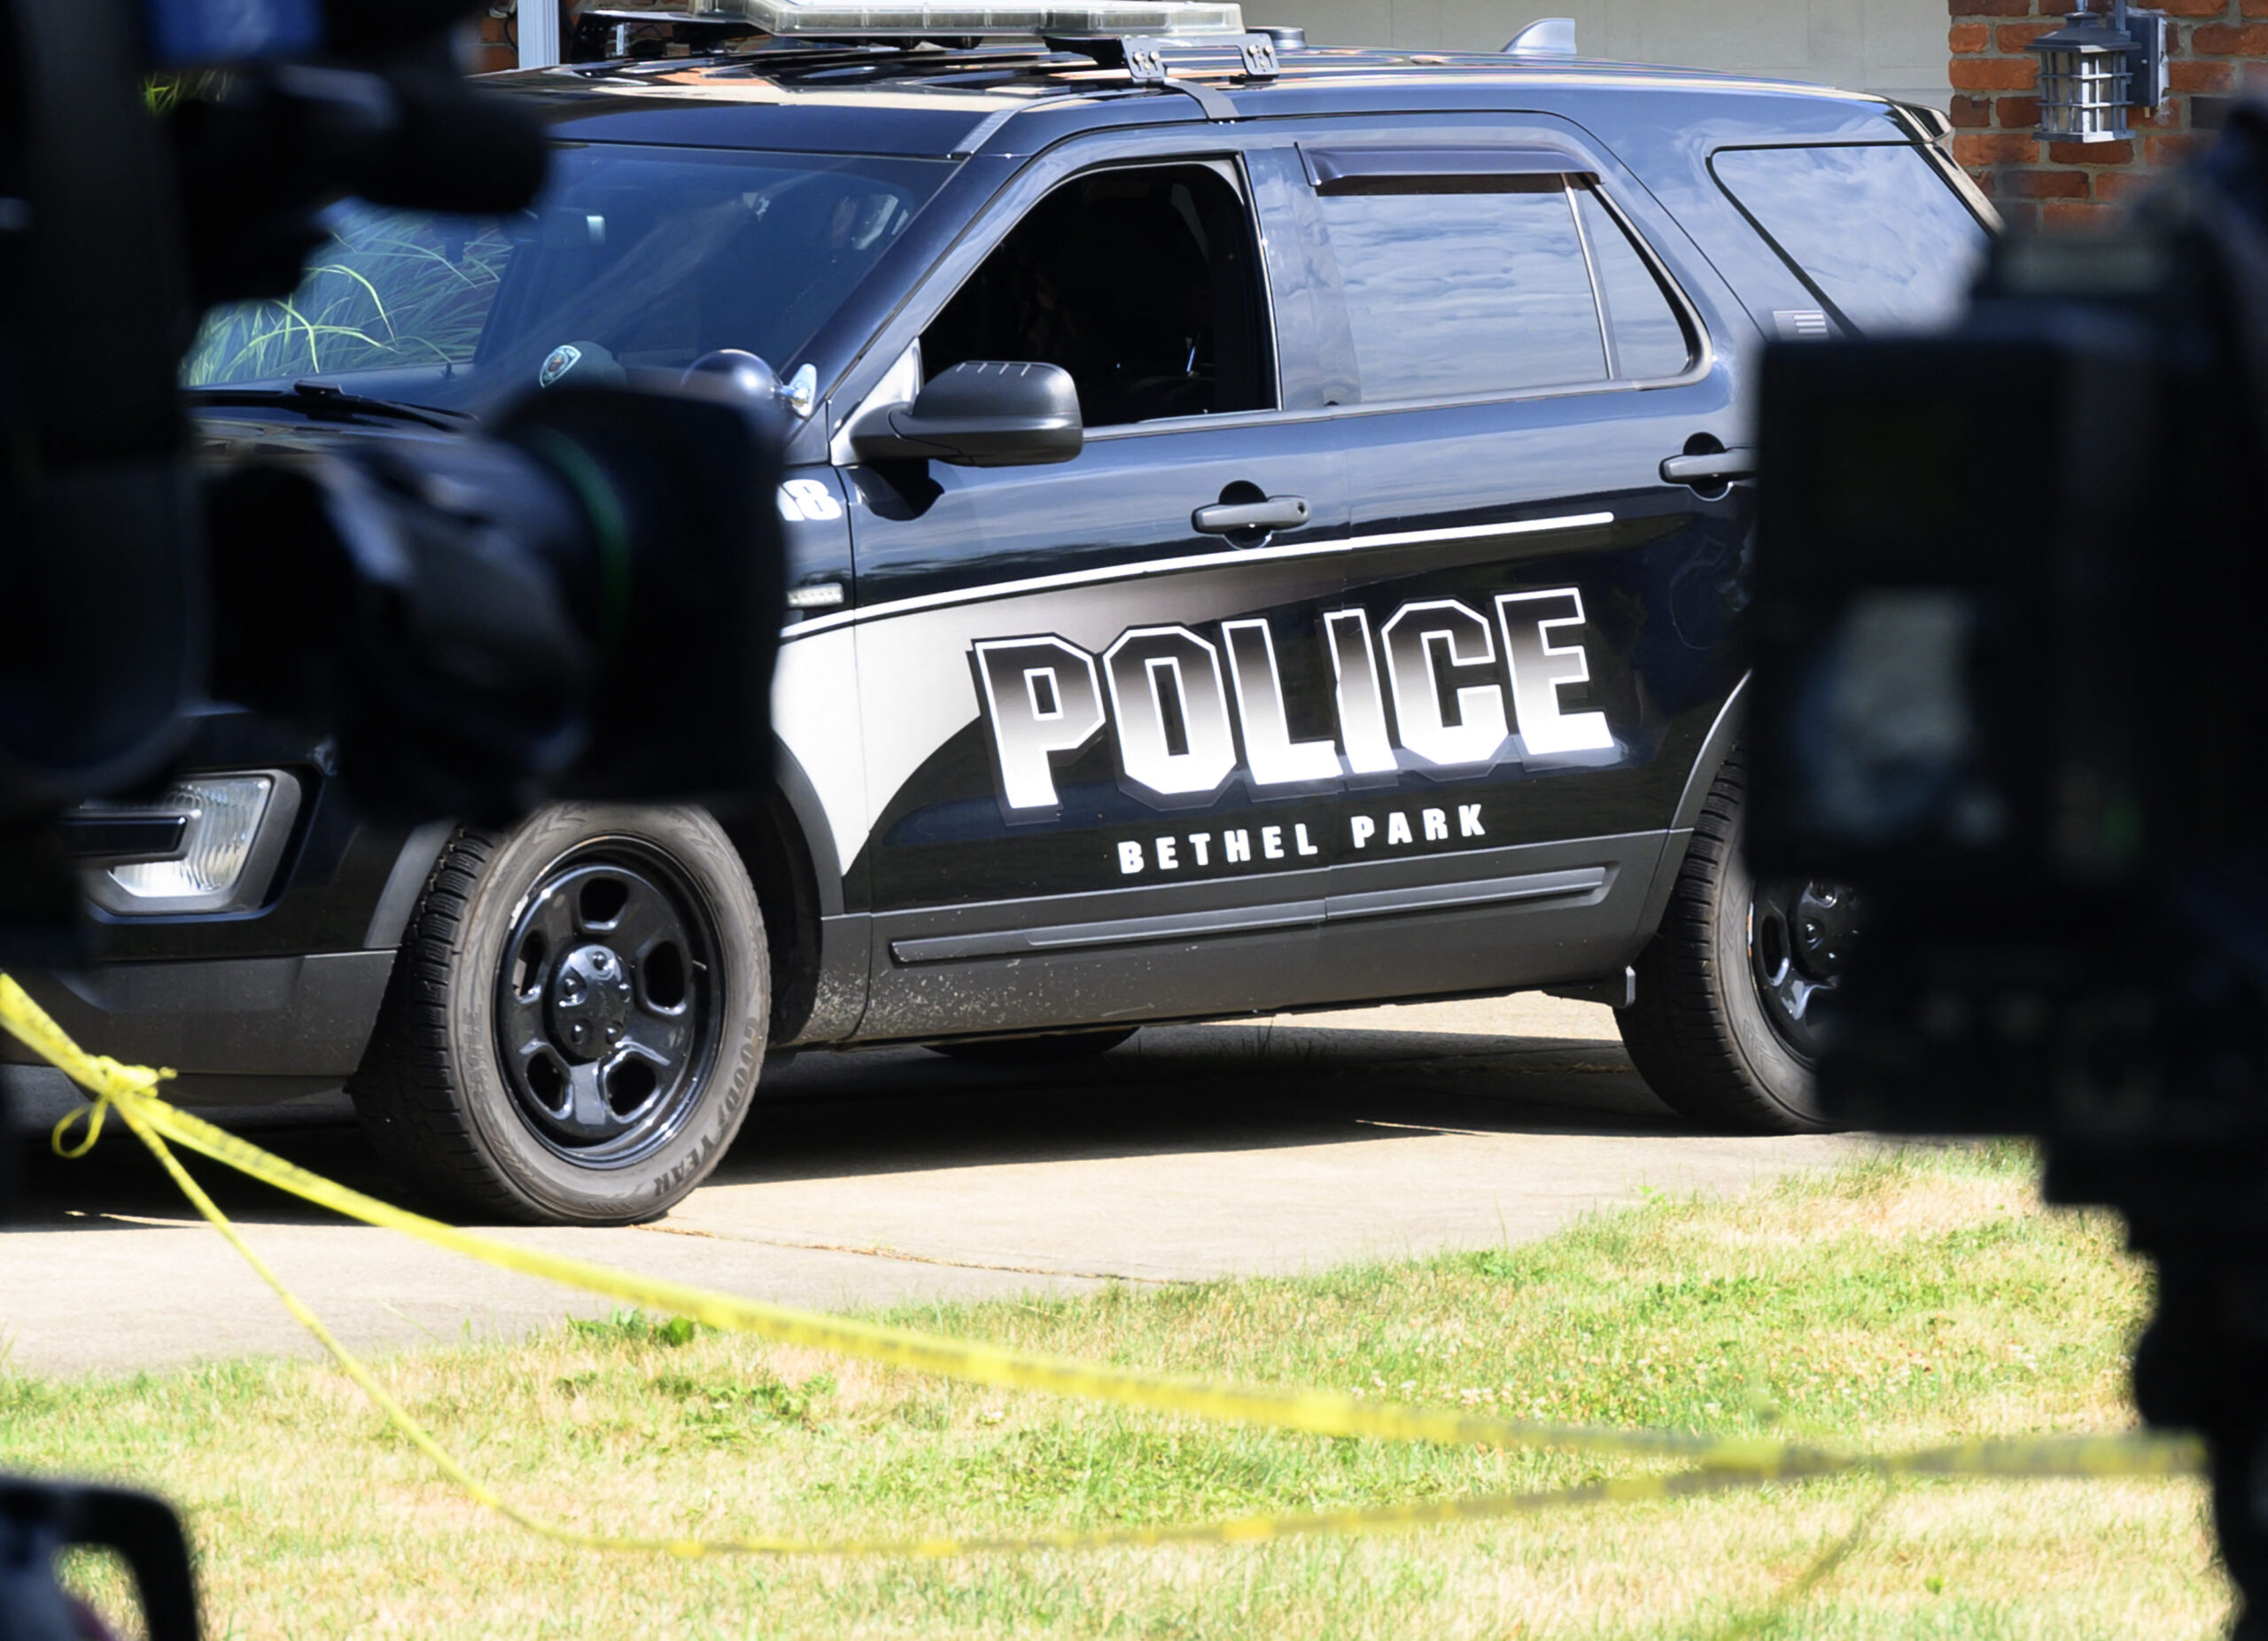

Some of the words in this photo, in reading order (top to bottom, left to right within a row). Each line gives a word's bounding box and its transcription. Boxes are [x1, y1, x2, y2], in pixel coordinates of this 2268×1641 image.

[974, 587, 1615, 809] POLICE
[1117, 823, 1318, 875] BETHEL
[1350, 804, 1486, 849] PARK
